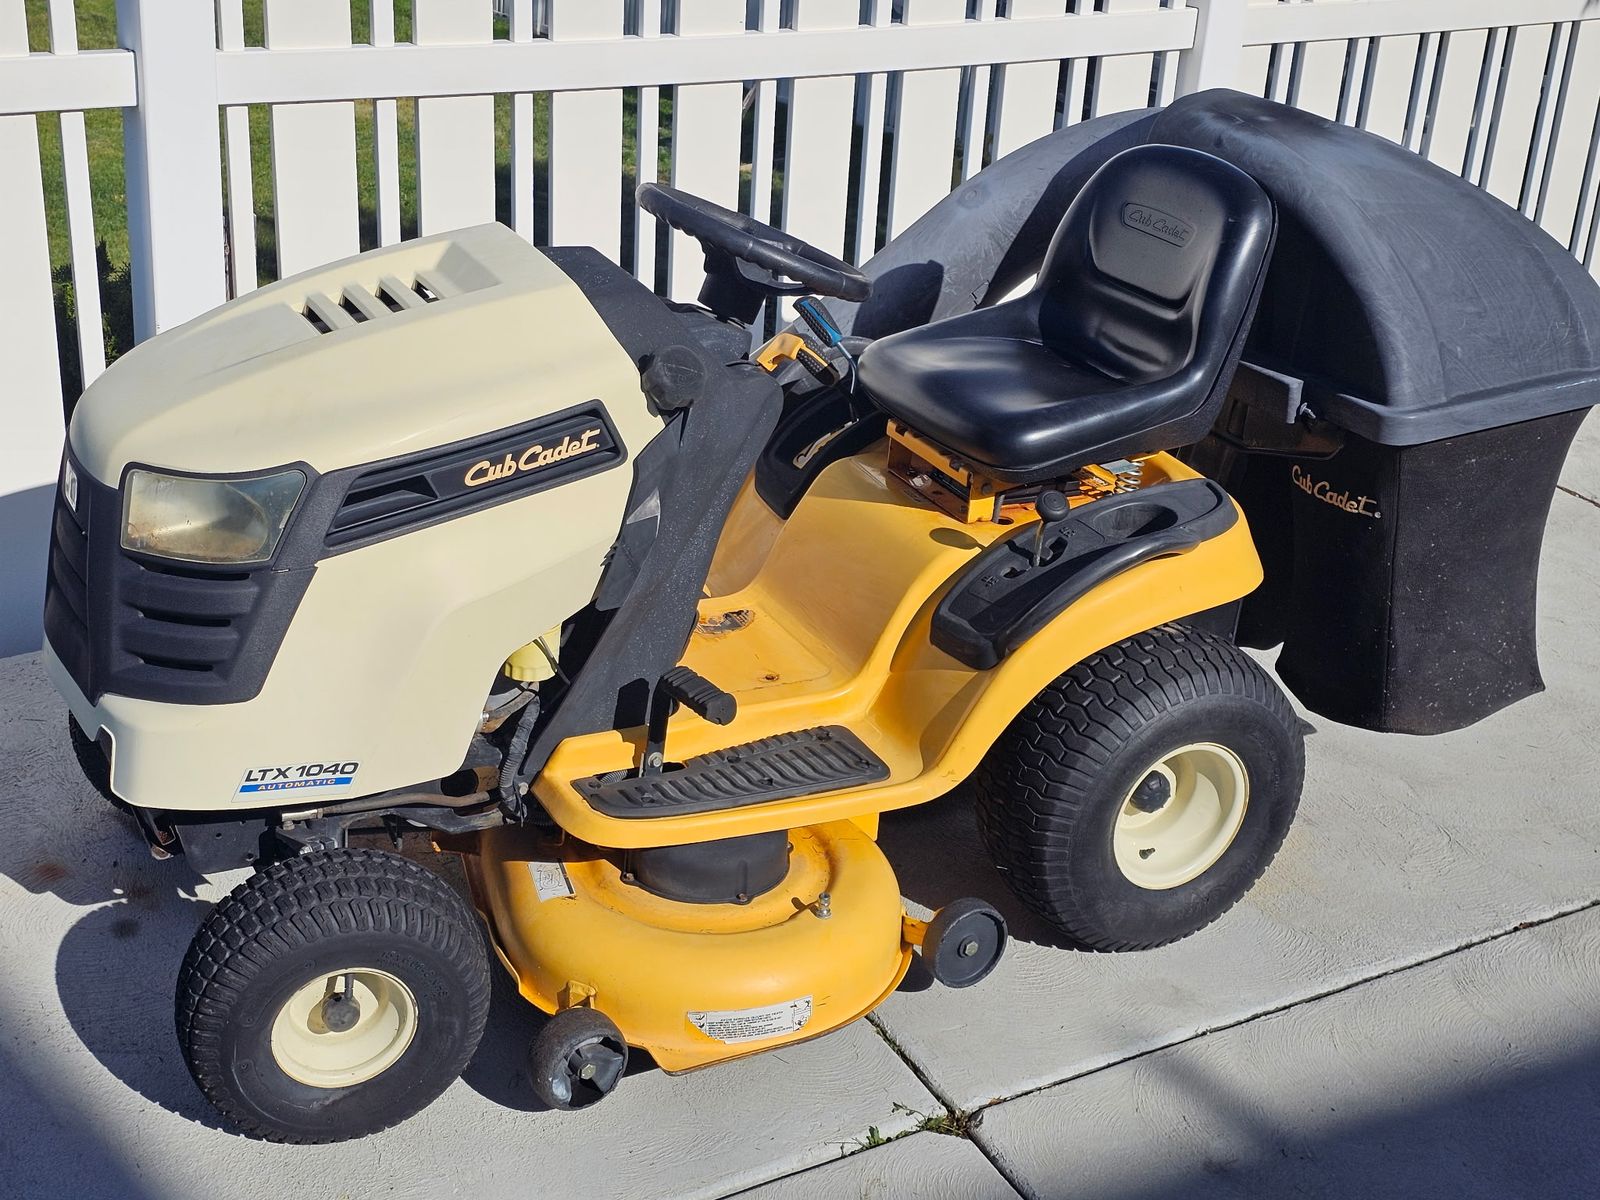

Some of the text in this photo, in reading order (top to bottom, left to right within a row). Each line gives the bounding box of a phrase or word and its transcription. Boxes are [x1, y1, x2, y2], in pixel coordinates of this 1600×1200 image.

[1128, 209, 1189, 241] Cub Cadet
[464, 428, 600, 487] Cub Cadet
[1292, 464, 1377, 517] Cub Cadet
[244, 762, 360, 783] LTX 1040
[257, 778, 336, 791] AUTOMATIC
